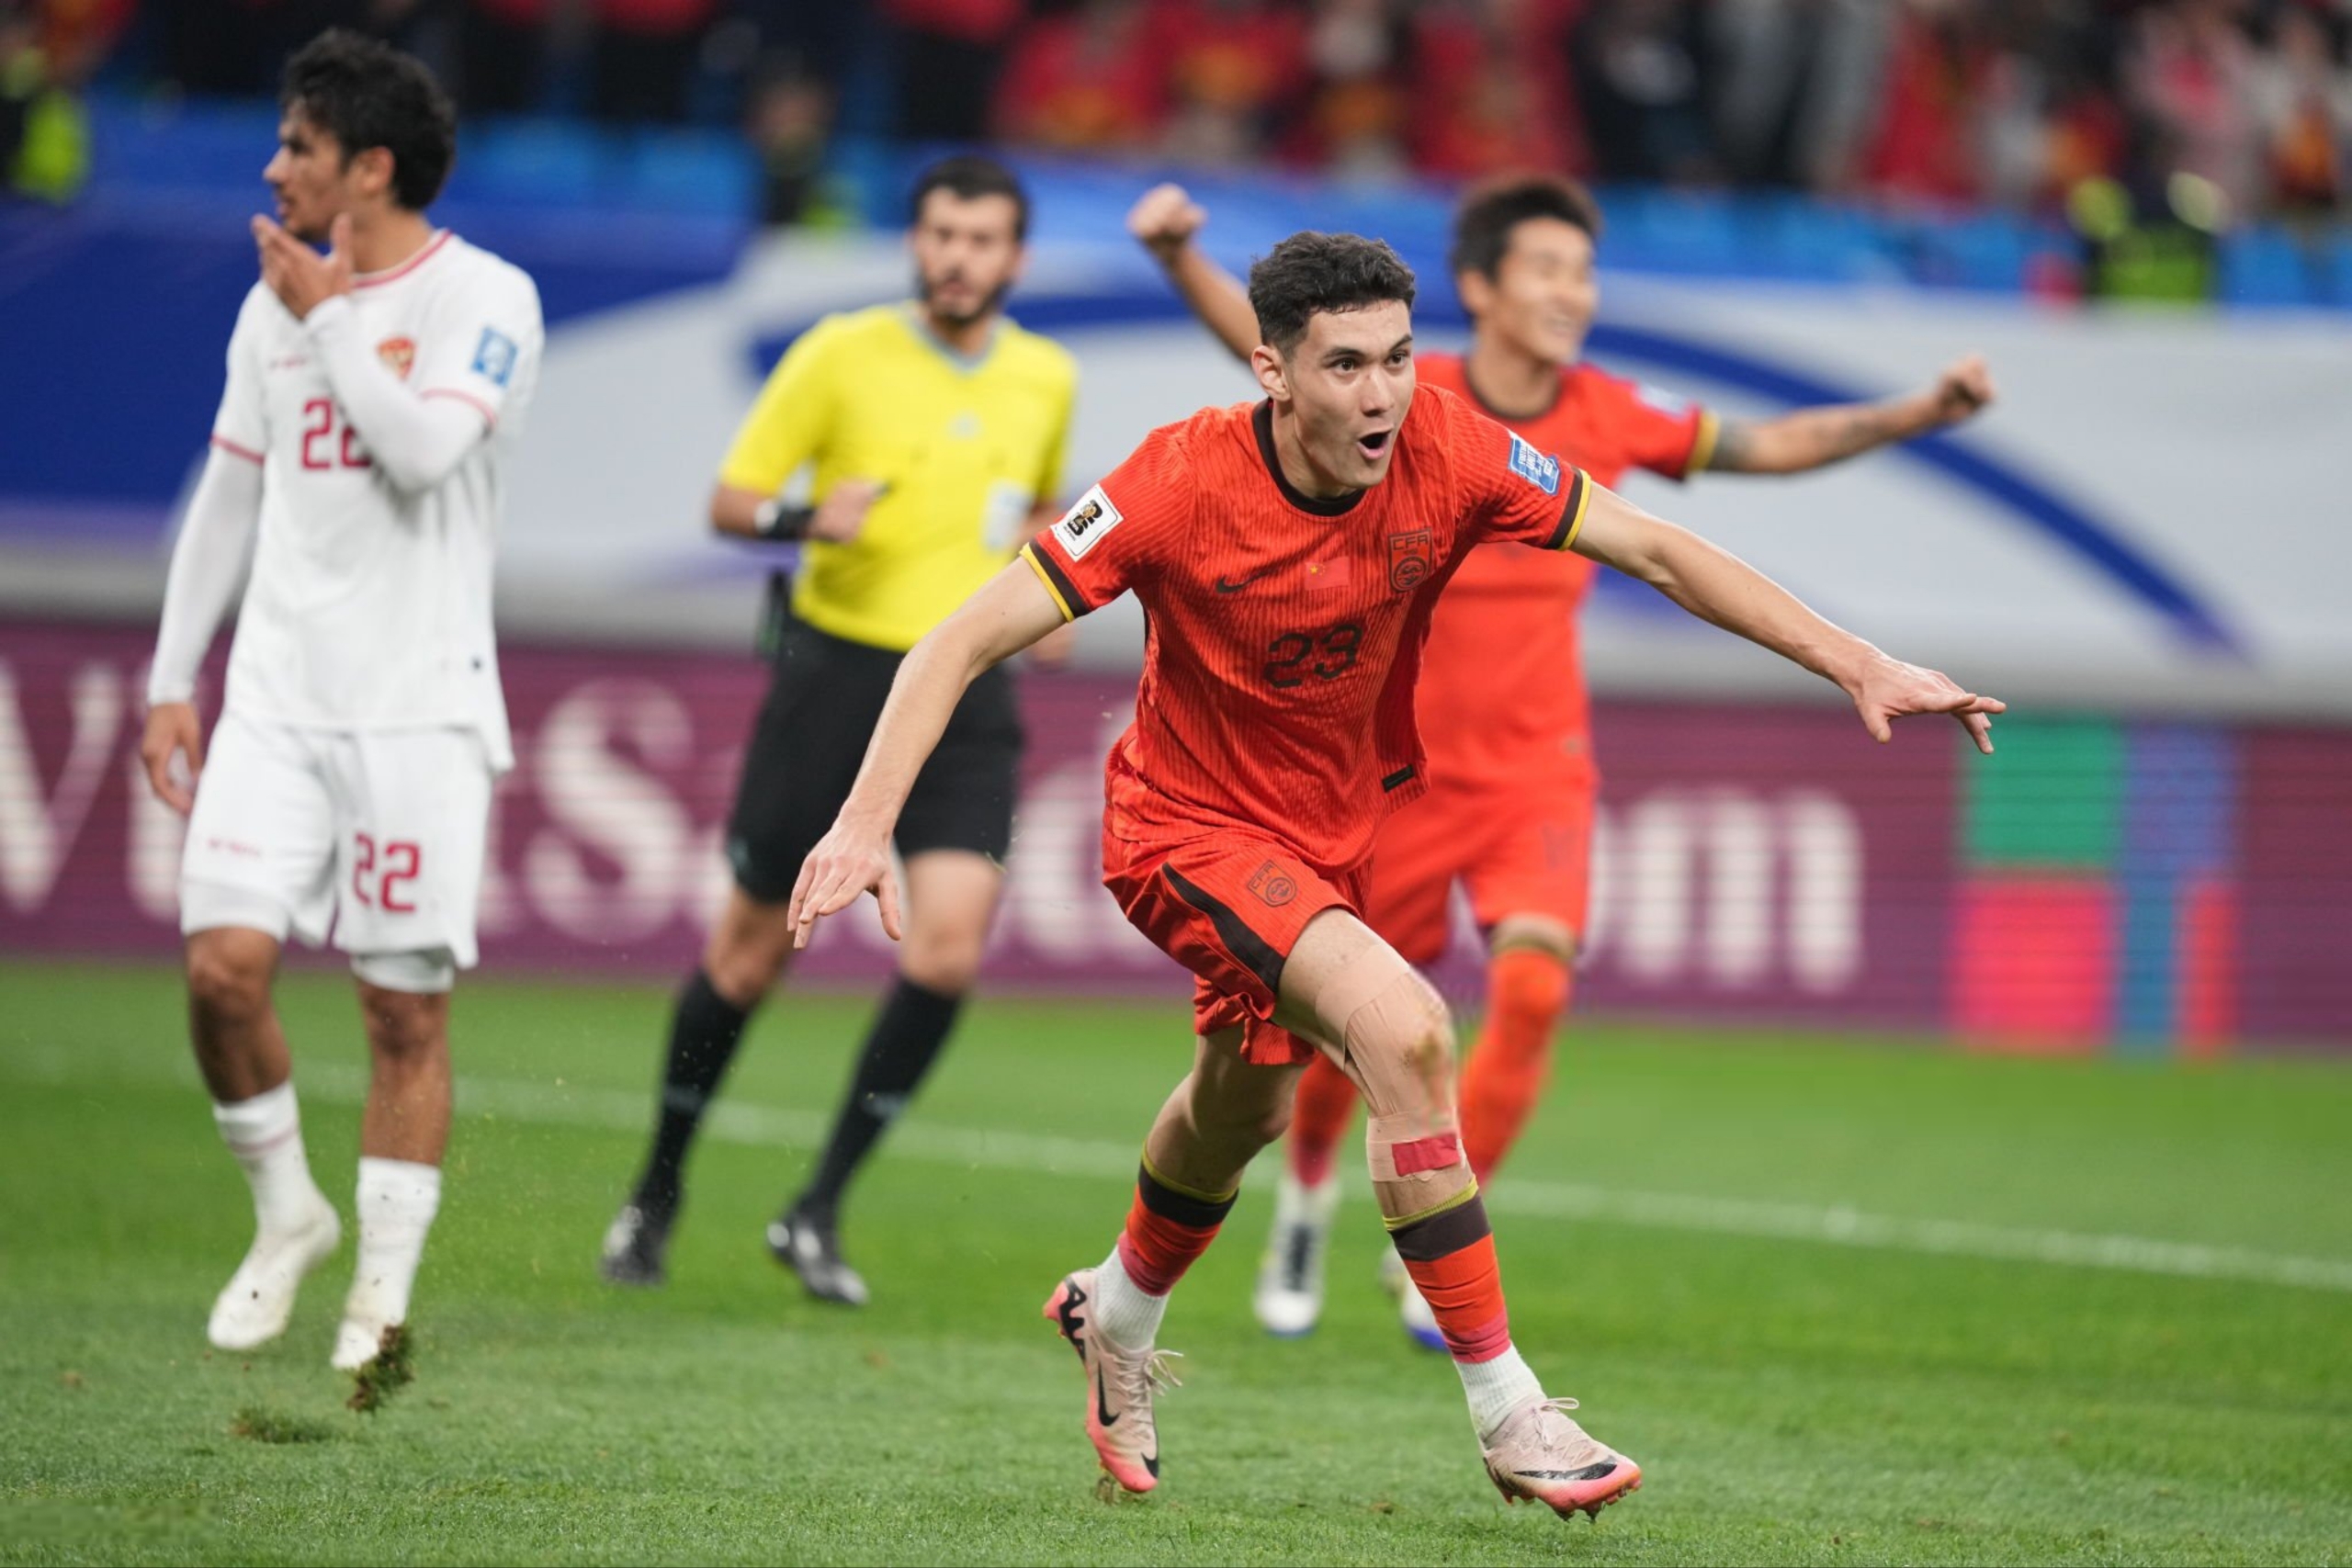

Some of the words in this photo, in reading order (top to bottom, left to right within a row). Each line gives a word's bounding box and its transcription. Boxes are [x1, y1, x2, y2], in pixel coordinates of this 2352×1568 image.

[1393, 534, 1429, 550] CFA
[1262, 624, 1363, 688] 23
[353, 830, 420, 912] 22
